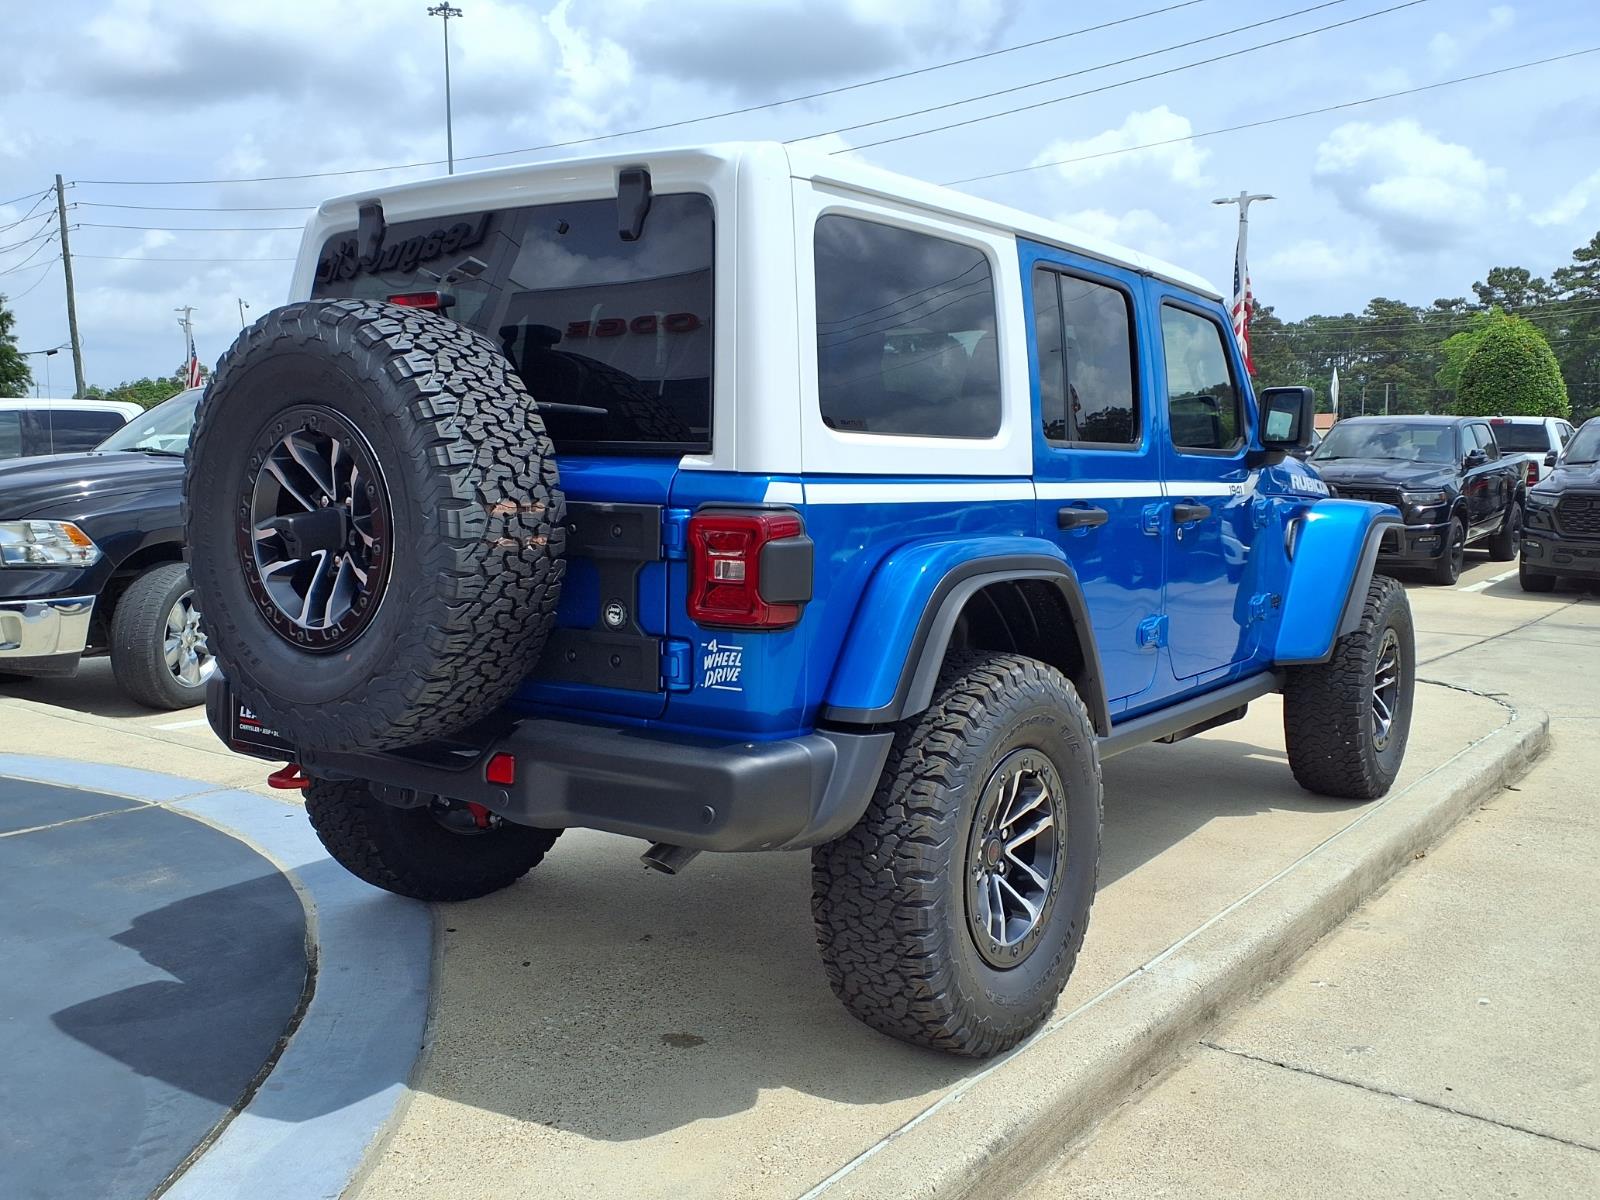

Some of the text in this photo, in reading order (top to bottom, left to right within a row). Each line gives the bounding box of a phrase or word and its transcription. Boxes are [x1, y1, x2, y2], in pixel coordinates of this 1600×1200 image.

[707, 638, 718, 653] 4
[703, 651, 742, 670] WHEEL
[704, 667, 742, 688] DRIVE
[240, 724, 260, 732] CHRYSLER
